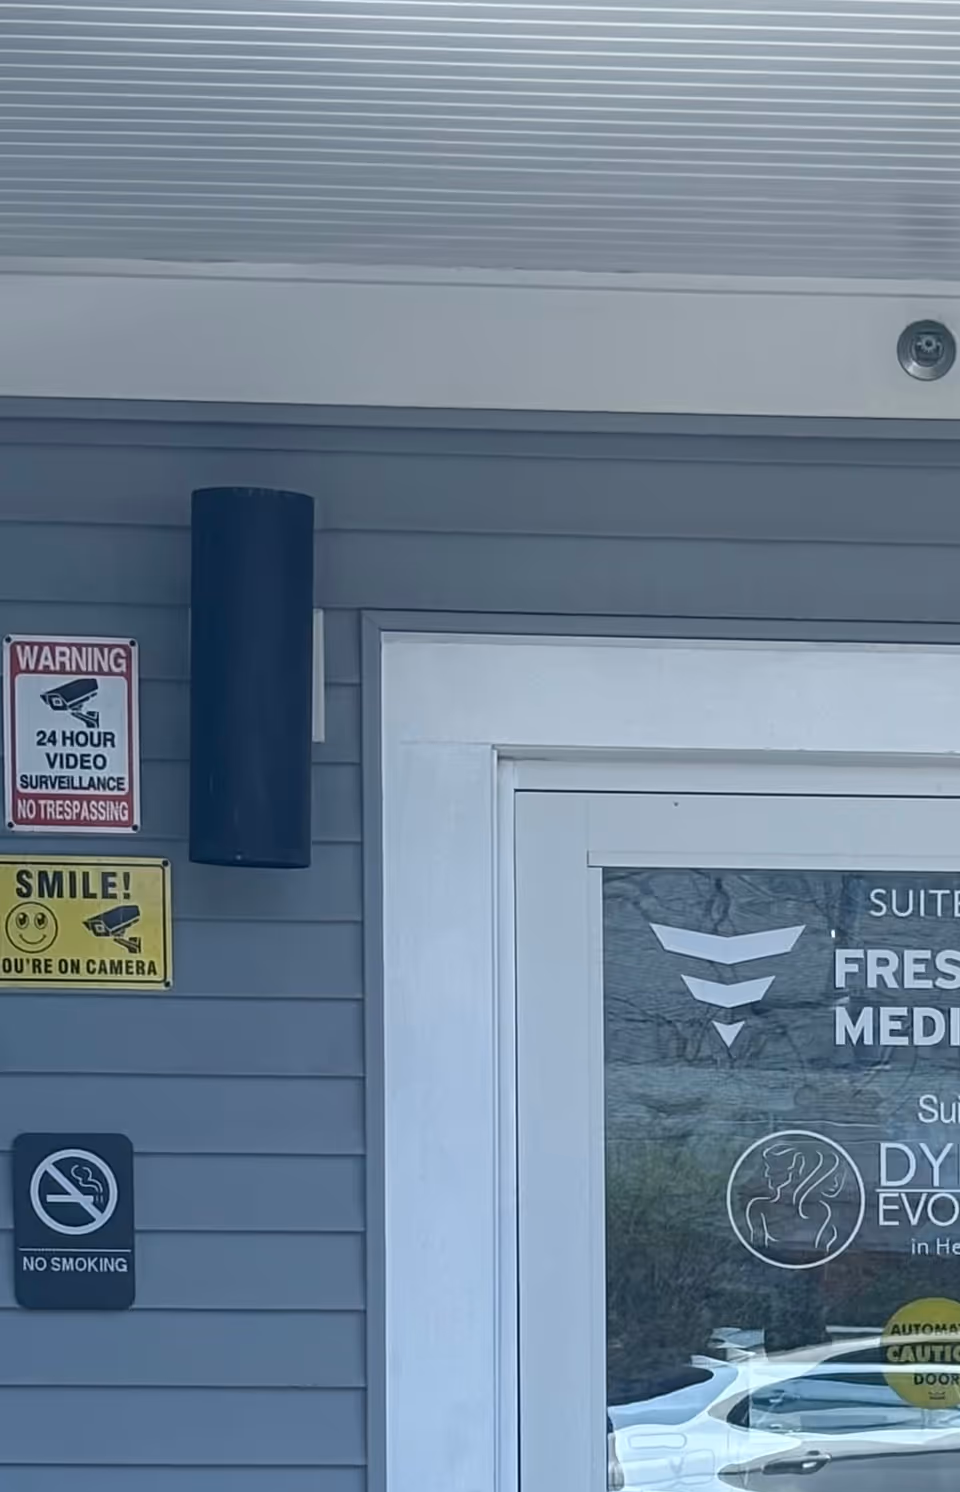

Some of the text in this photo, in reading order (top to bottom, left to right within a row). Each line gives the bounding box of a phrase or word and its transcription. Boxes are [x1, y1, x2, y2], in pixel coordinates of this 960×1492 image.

[16, 645, 127, 673] WARNING
[36, 730, 115, 748] 24 HOUR
[45, 752, 107, 769] VIDEO
[20, 775, 125, 791] SURVEILLANCE
[17, 798, 128, 821] NO TRESPASSING
[16, 869, 131, 899] SMILE!
[58, 959, 80, 974] ON
[86, 959, 157, 976] CAMERA
[911, 1239, 929, 1255] in
[23, 1256, 128, 1272] NO SMOKING
[914, 1373, 960, 1385] DOOR
